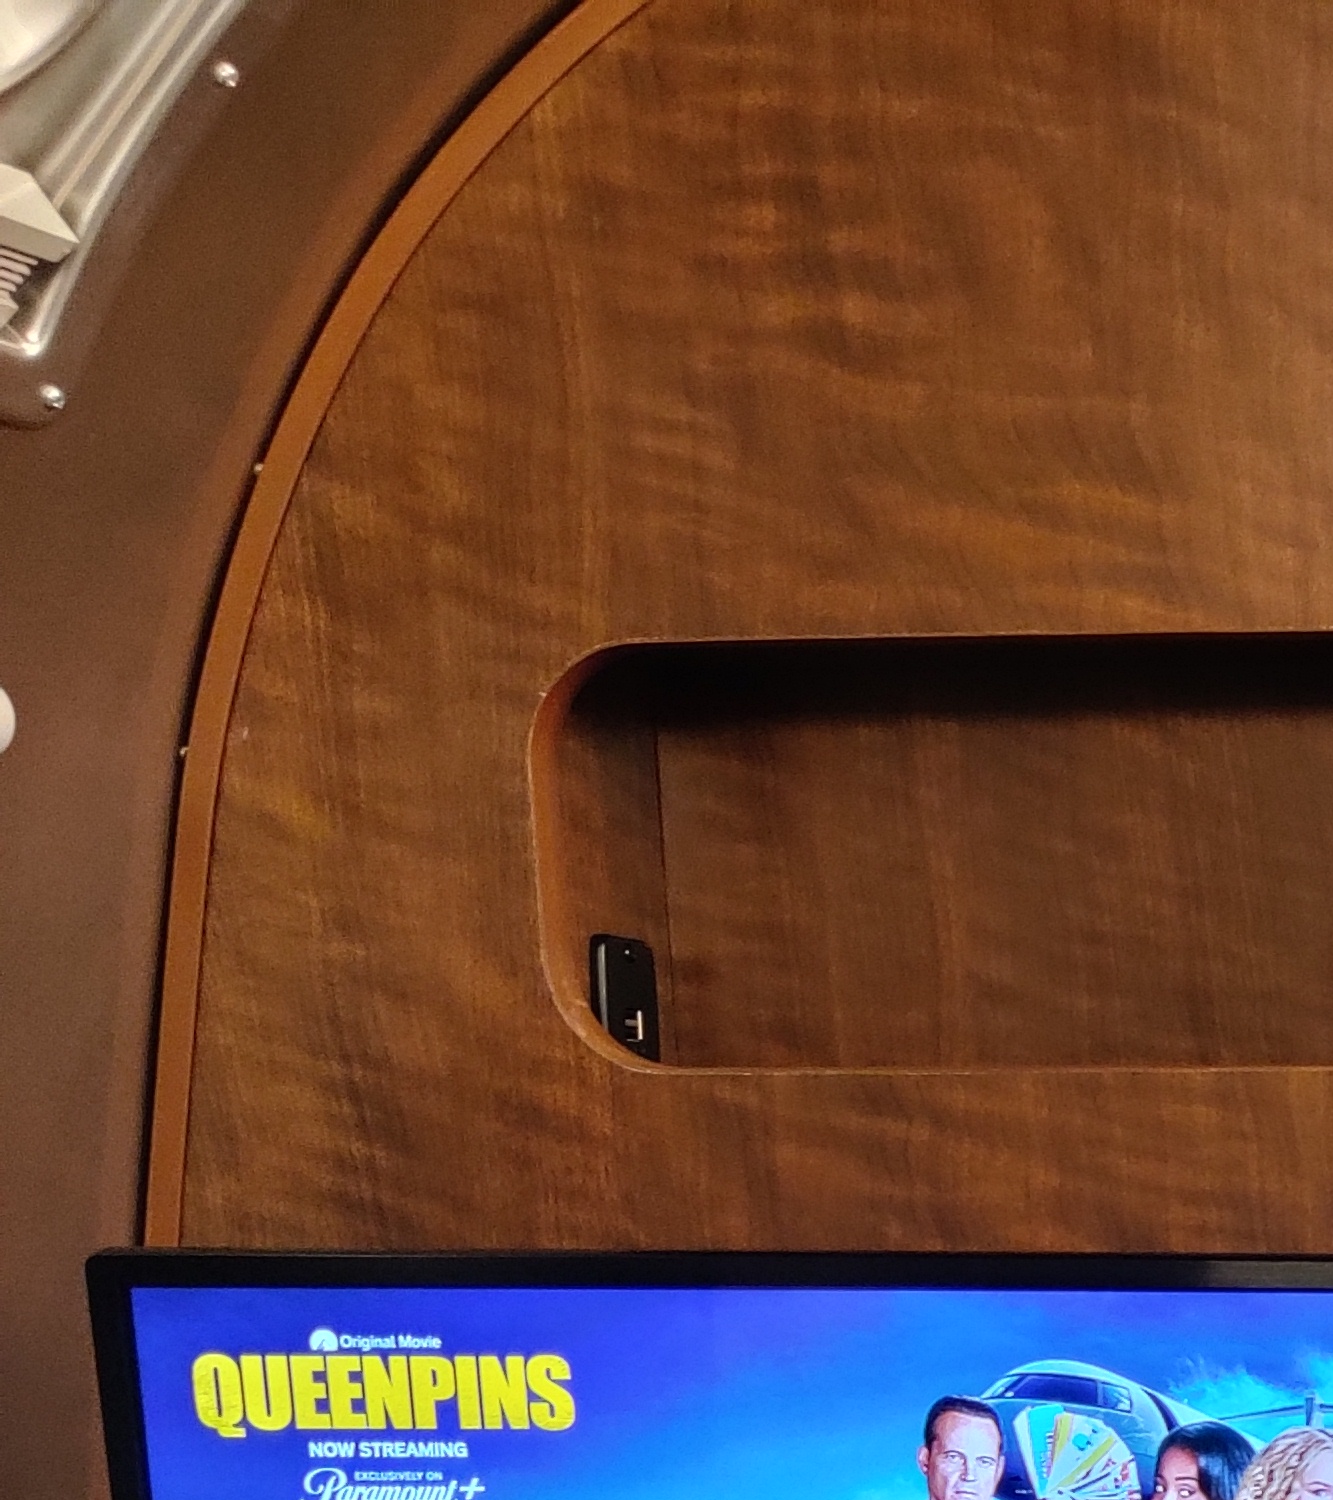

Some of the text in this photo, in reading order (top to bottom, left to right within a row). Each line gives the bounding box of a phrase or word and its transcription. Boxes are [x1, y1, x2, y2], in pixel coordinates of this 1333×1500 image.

[339, 1334, 441, 1351] Original Movie
[191, 1353, 577, 1439] QUEENPINS
[308, 1441, 469, 1458] NOW STREAMING
[353, 1470, 443, 1481] EXCLUSIVELY ON
